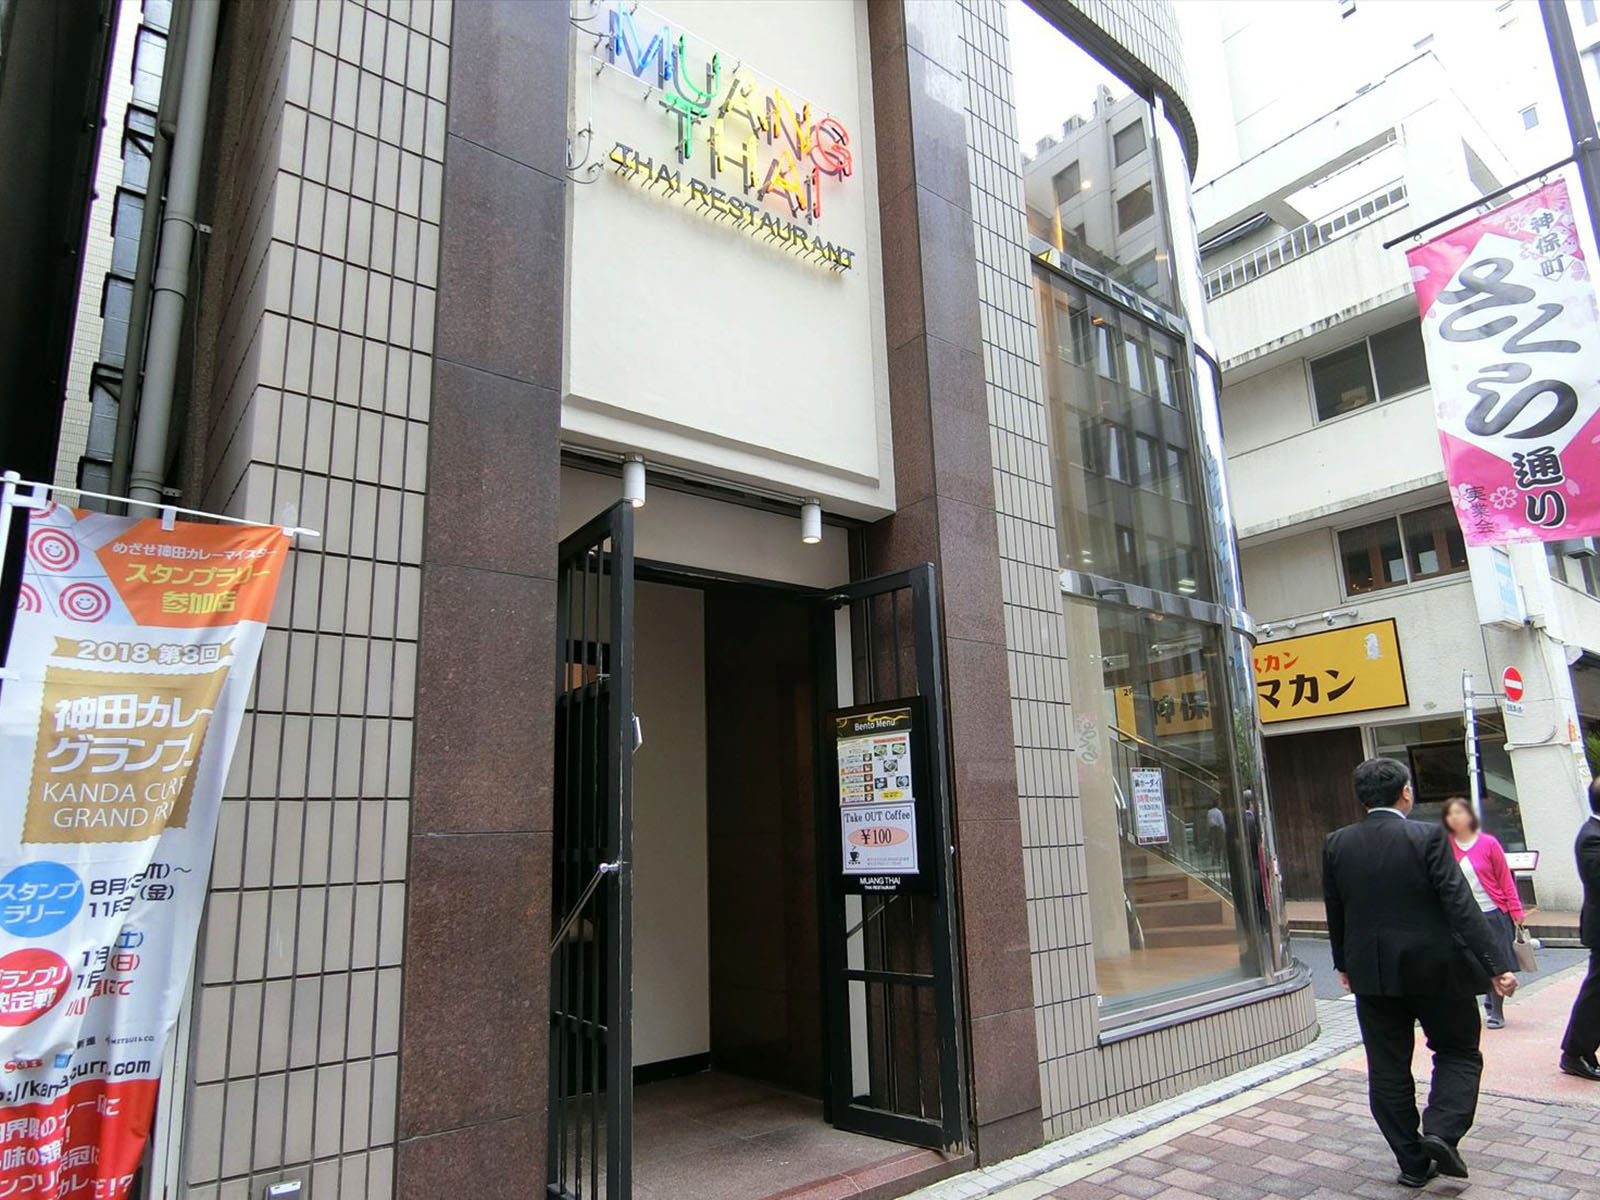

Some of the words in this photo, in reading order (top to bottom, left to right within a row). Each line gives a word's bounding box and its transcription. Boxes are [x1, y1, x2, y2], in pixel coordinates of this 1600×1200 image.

[610, 0, 853, 179] MUANG
[660, 92, 820, 222] THAI
[609, 141, 682, 193] THAI
[688, 177, 855, 270] RESTAURANT
[1530, 211, 1564, 278] 神保町
[1464, 485, 1494, 534] 実業会
[124, 563, 271, 588] スタンプラリー
[161, 590, 237, 615] 参加店
[76, 639, 150, 663] 2018
[157, 643, 222, 665] 第8回
[854, 721, 875, 732] Bento
[876, 718, 896, 729] Menu
[43, 782, 137, 803] KANDA
[53, 806, 148, 828] GRAND
[844, 812, 863, 823] Take
[864, 811, 882, 822] OUT
[885, 809, 911, 821] Coffee
[861, 828, 892, 845] ¥100
[860, 876, 883, 885] MUANG
[884, 876, 901, 885] THAI
[4, 903, 66, 924] ラリー
